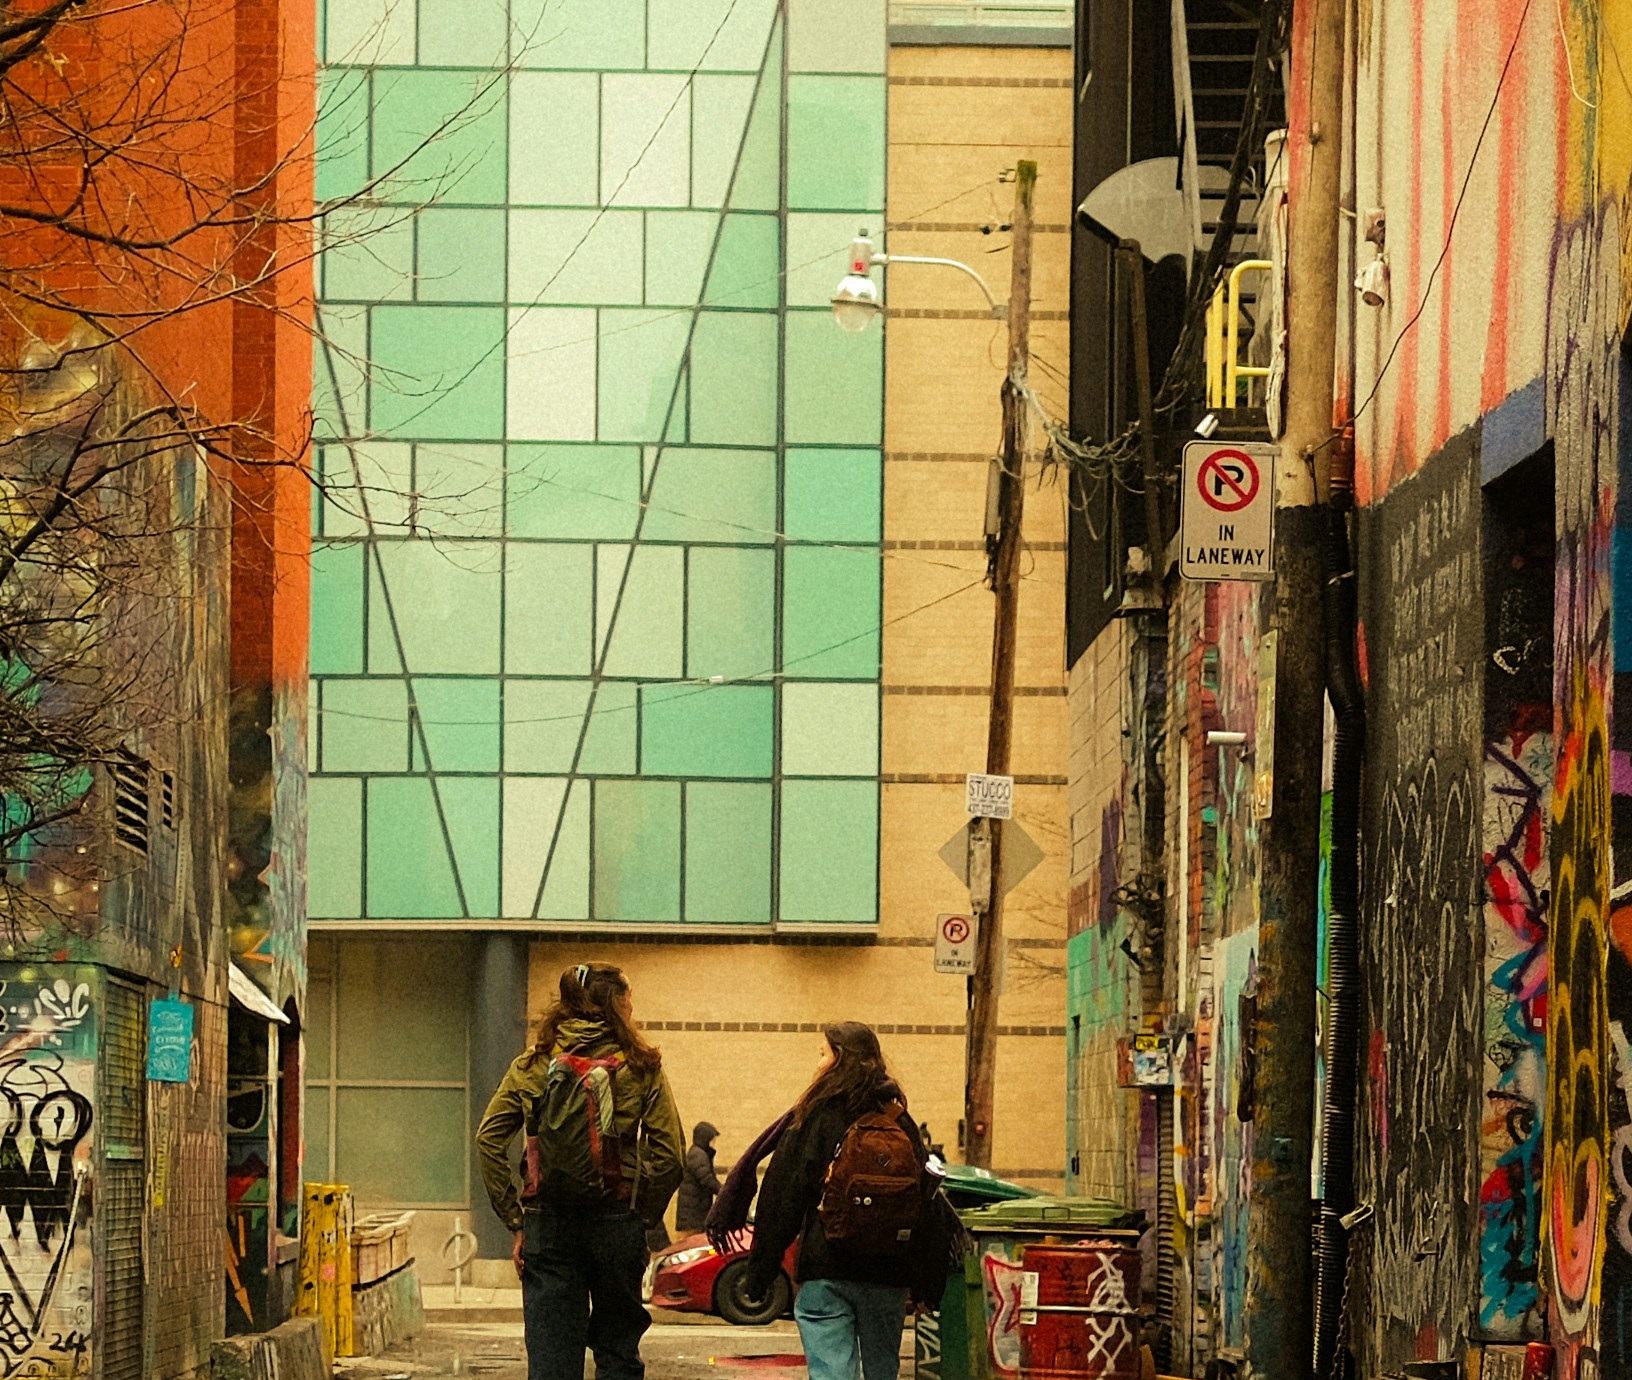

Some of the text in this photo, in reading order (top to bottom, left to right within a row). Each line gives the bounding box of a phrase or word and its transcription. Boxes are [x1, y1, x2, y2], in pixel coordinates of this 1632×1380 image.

[1218, 524, 1235, 541] IN
[1186, 546, 1265, 566] LANEWAY
[968, 779, 1011, 800] STUCCO
